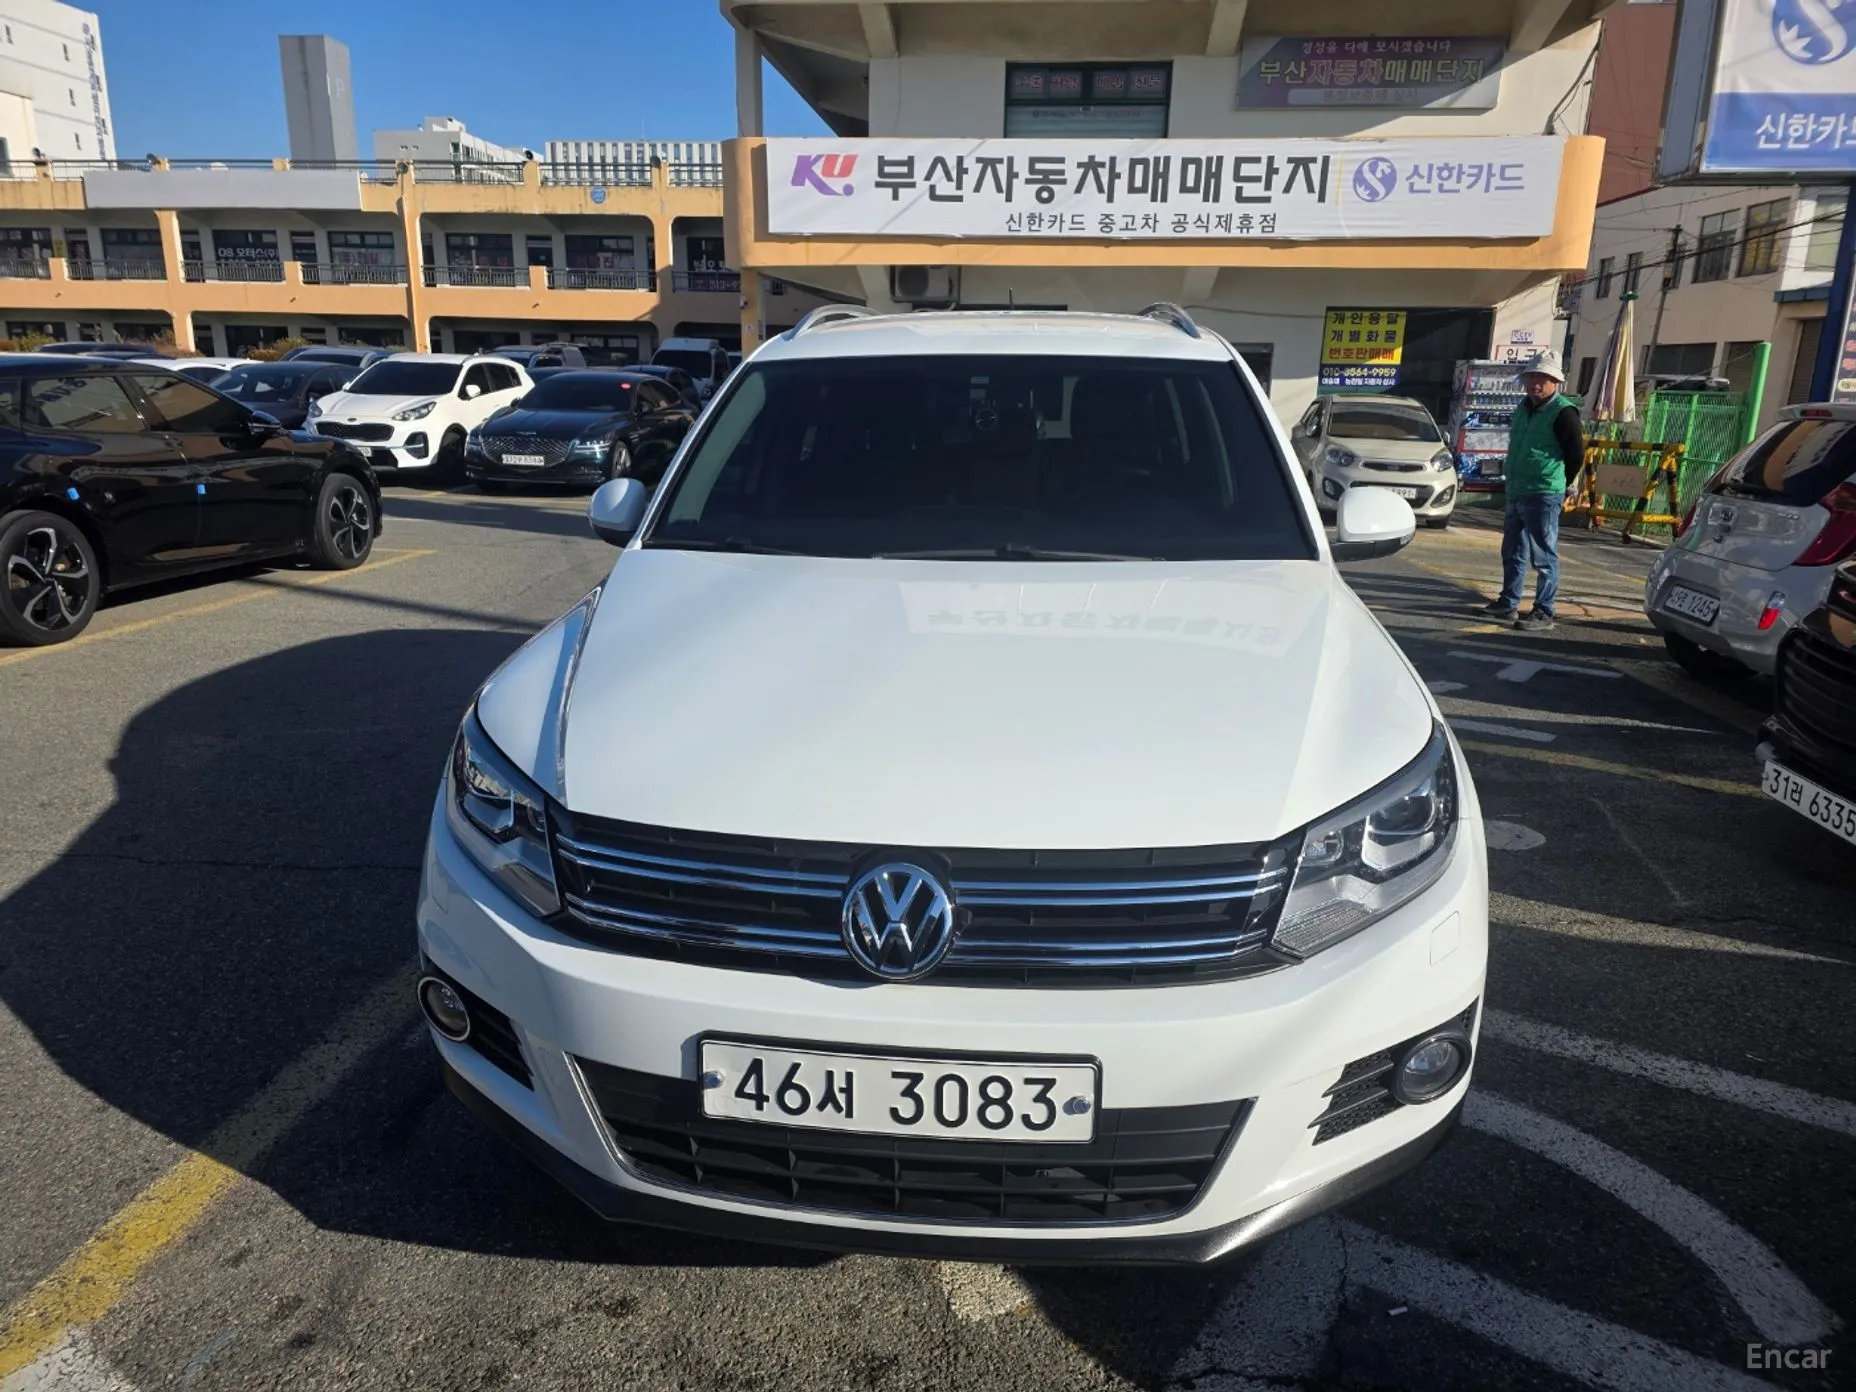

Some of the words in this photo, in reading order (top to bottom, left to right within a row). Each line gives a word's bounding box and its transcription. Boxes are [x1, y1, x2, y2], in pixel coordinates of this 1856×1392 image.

[1259, 58, 1485, 85] 부산자동차매매단지
[874, 154, 1331, 203] 부산자동차매매단지
[1405, 162, 1524, 194] 신한카드
[1005, 213, 1086, 233] 신한카드
[1098, 212, 1160, 233] 중고차
[1171, 212, 1278, 234] 공식제휴점
[1809, 791, 1856, 837] 6335
[733, 1057, 854, 1119] 46서
[889, 1070, 1058, 1132] 3083
